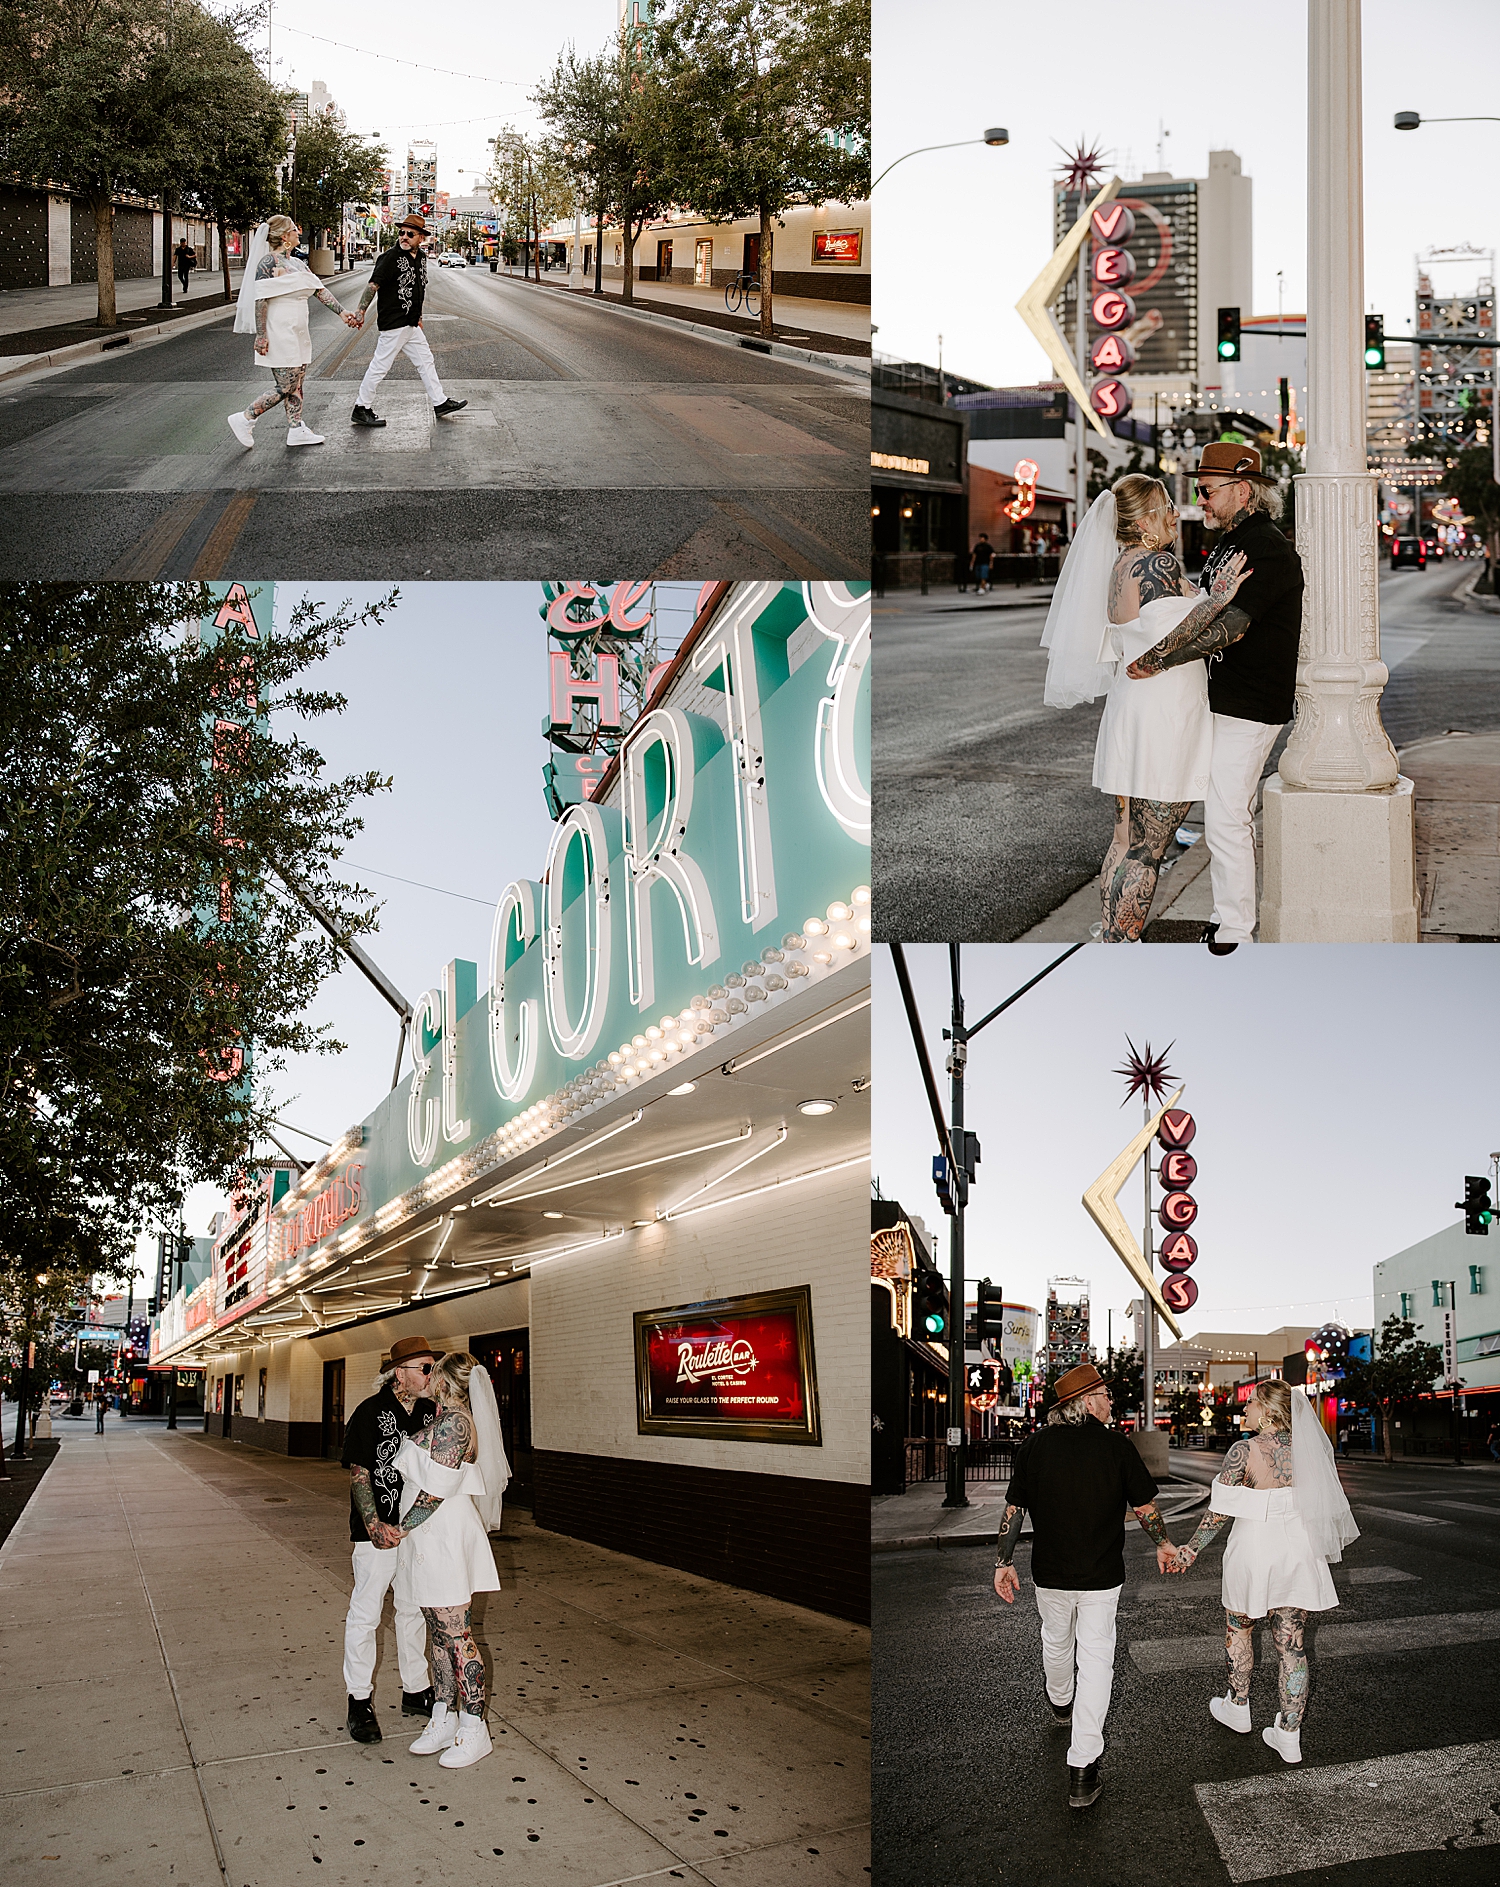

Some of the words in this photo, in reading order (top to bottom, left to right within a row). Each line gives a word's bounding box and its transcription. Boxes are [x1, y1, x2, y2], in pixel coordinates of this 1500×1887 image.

[1174, 194, 1189, 254] VEGAS
[1174, 262, 1189, 296] LAS
[1092, 204, 1127, 416] VEGAS
[1163, 1113, 1198, 1308] VEGAS
[677, 1341, 731, 1383] Roulette
[733, 1351, 751, 1361] BAR
